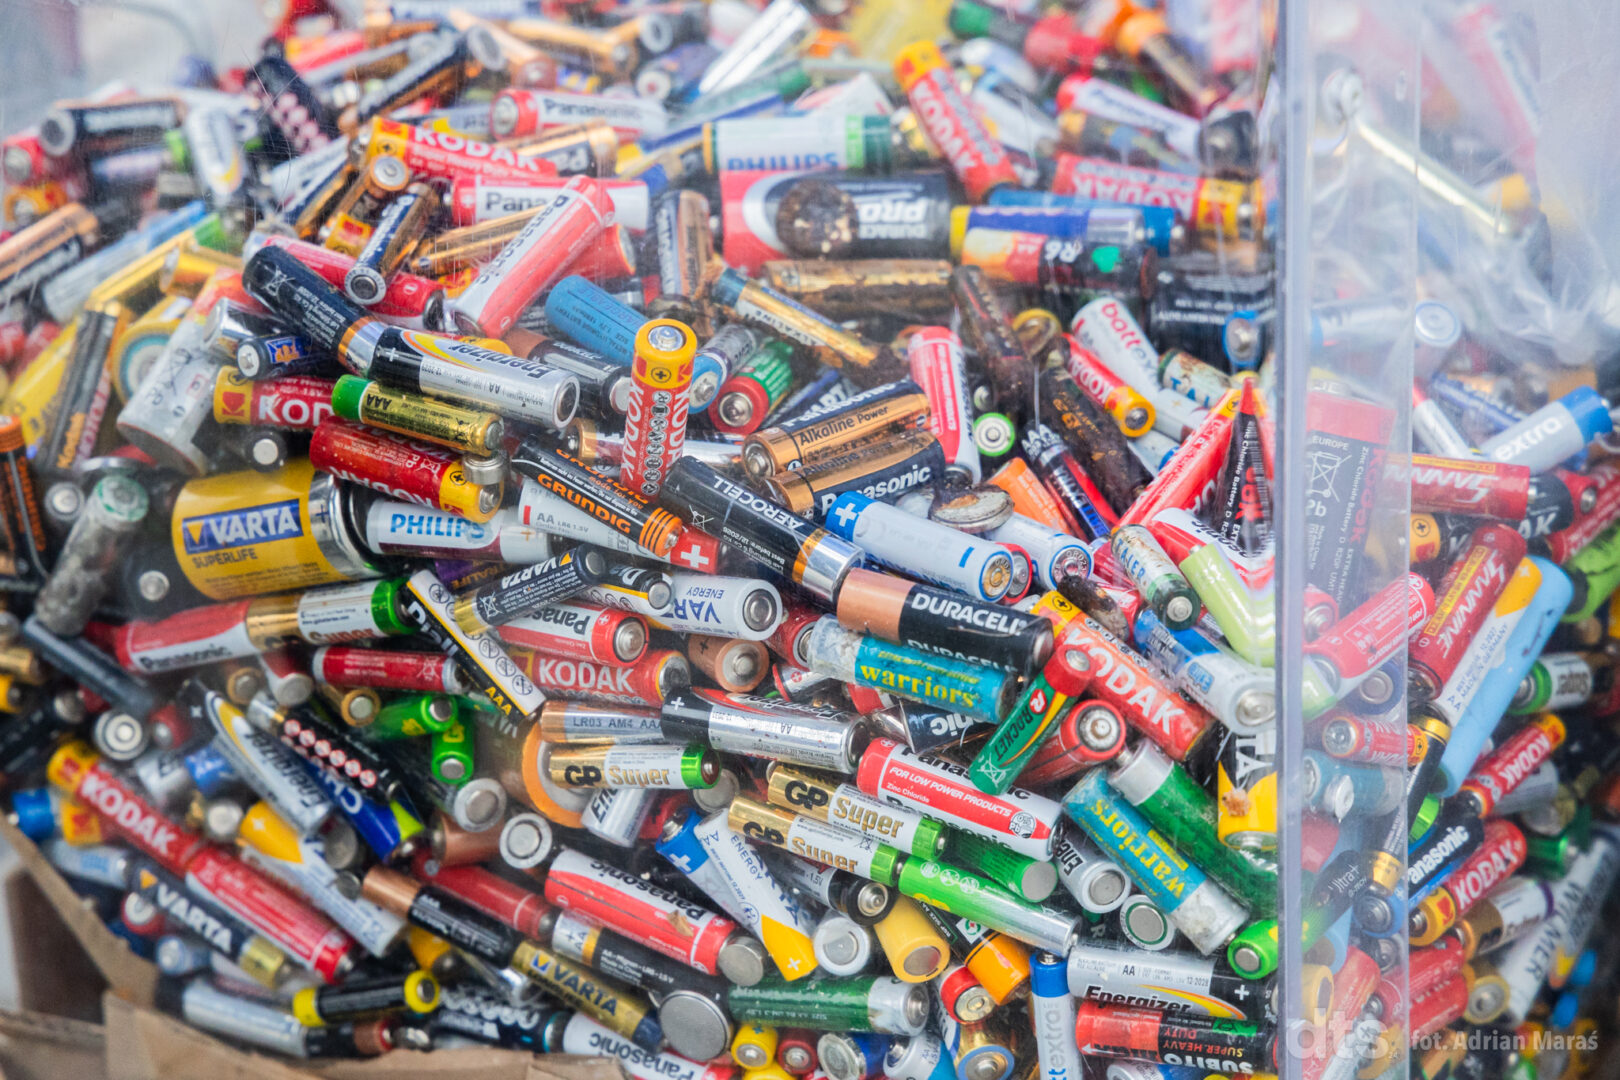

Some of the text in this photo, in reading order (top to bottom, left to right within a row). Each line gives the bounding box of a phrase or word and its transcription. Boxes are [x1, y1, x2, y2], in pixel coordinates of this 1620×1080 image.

[911, 79, 978, 171] KODAK
[413, 127, 540, 171] KODAK
[727, 151, 840, 170] PHILIPS
[485, 191, 547, 213] Pana
[858, 199, 930, 223] PRO
[1074, 176, 1196, 222] KODAK
[477, 194, 570, 286] Panasonic
[1043, 239, 1083, 263] R6
[449, 346, 552, 381] Energizer
[366, 394, 393, 409] AAA
[485, 381, 502, 395] AA
[258, 396, 333, 426] KOD
[665, 384, 691, 469] KODA
[796, 403, 890, 447] Alkaline Power
[620, 382, 644, 481] KODAK
[1312, 434, 1349, 451] EUROPE
[1494, 414, 1563, 462] extra
[403, 451, 421, 470] Pb
[1234, 439, 1249, 475] Chloride
[1357, 445, 1370, 465] Zinc
[329, 465, 435, 510] KODAK
[586, 474, 645, 511] made for you
[821, 465, 931, 515] Pasonic
[1224, 474, 1241, 508] Battery
[1347, 465, 1364, 501] Chloride
[536, 512, 555, 524] AA
[537, 473, 632, 535] GRUNDIG
[713, 473, 805, 531] AEROCELL
[1338, 500, 1355, 533] Battery
[208, 505, 300, 546] VARTA
[389, 513, 486, 540] PHILIPS
[192, 548, 258, 570] SUPERLIFE
[747, 539, 772, 556] before:
[769, 551, 786, 565] Best
[500, 556, 558, 590] VARTA
[684, 583, 724, 601] ENERGY
[911, 592, 1022, 637] DURACELL
[538, 659, 637, 694] KODAK
[1458, 675, 1479, 700] MADE
[1480, 620, 1511, 663] GERMANY
[484, 686, 513, 716] AAA
[859, 664, 974, 709] warriors
[572, 717, 604, 728] LR03
[608, 717, 634, 729] AM4
[780, 722, 793, 735] AA
[564, 765, 602, 787] GP
[608, 765, 671, 788] Super
[901, 745, 1031, 801] Panasic
[1498, 732, 1551, 791] KODAK
[784, 780, 829, 811] GP
[884, 780, 931, 806] Zinc Chloride
[887, 764, 1013, 819] FOR LOW POWER PRODUCTS
[81, 773, 177, 856] KODAK
[833, 795, 905, 840] Super
[742, 821, 785, 846] GP
[1089, 799, 1189, 899] warriors
[730, 835, 763, 882] ENERGY
[791, 836, 859, 873] Super
[590, 860, 706, 921] Panasonic
[1455, 839, 1517, 909] KODAK
[156, 882, 233, 952] VARTA
[1122, 964, 1136, 977] AA
[553, 965, 619, 1017] VARTA
[1084, 984, 1192, 1015] Energizer
[1161, 1038, 1244, 1058] SUPER HEAVY
[1163, 1028, 1197, 1041] DUTY
[588, 1032, 696, 1079] Panasonic
[1163, 1052, 1254, 1075] SUBITO
